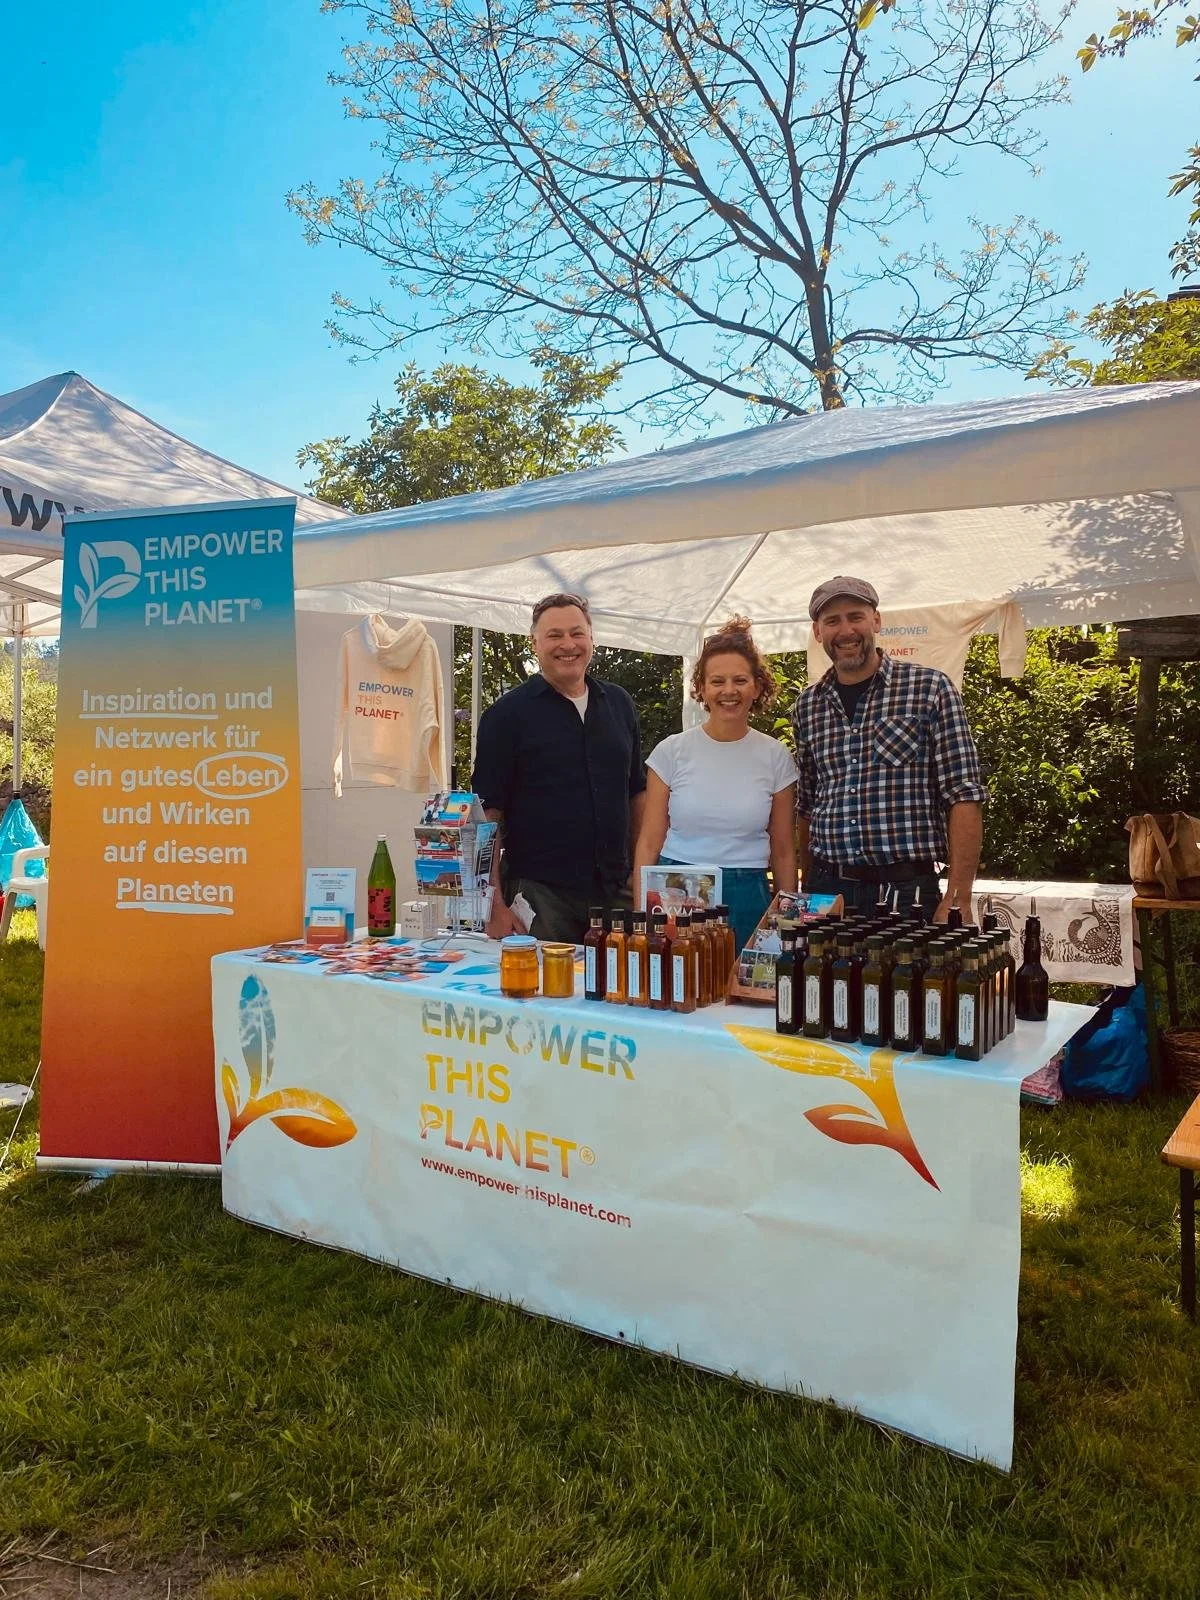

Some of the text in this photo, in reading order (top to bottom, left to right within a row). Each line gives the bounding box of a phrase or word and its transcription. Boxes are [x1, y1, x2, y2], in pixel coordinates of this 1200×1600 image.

[144, 529, 284, 561] EMPOWER
[144, 566, 207, 596] THIS
[880, 625, 929, 636] EMPOWER
[82, 686, 273, 715] Inspiration und
[358, 681, 414, 698] EMPOWER
[358, 694, 383, 705] THIS
[95, 725, 261, 749] Netzwerk für
[73, 763, 280, 793] ein gutes Leben
[102, 801, 251, 825] und Wirken
[103, 840, 248, 864] auf diesem
[116, 878, 234, 903] Planeten
[421, 999, 637, 1081] EMPOWER
[424, 1053, 512, 1104] THIS
[421, 1157, 632, 1229] www.empowerhisplanet.com
